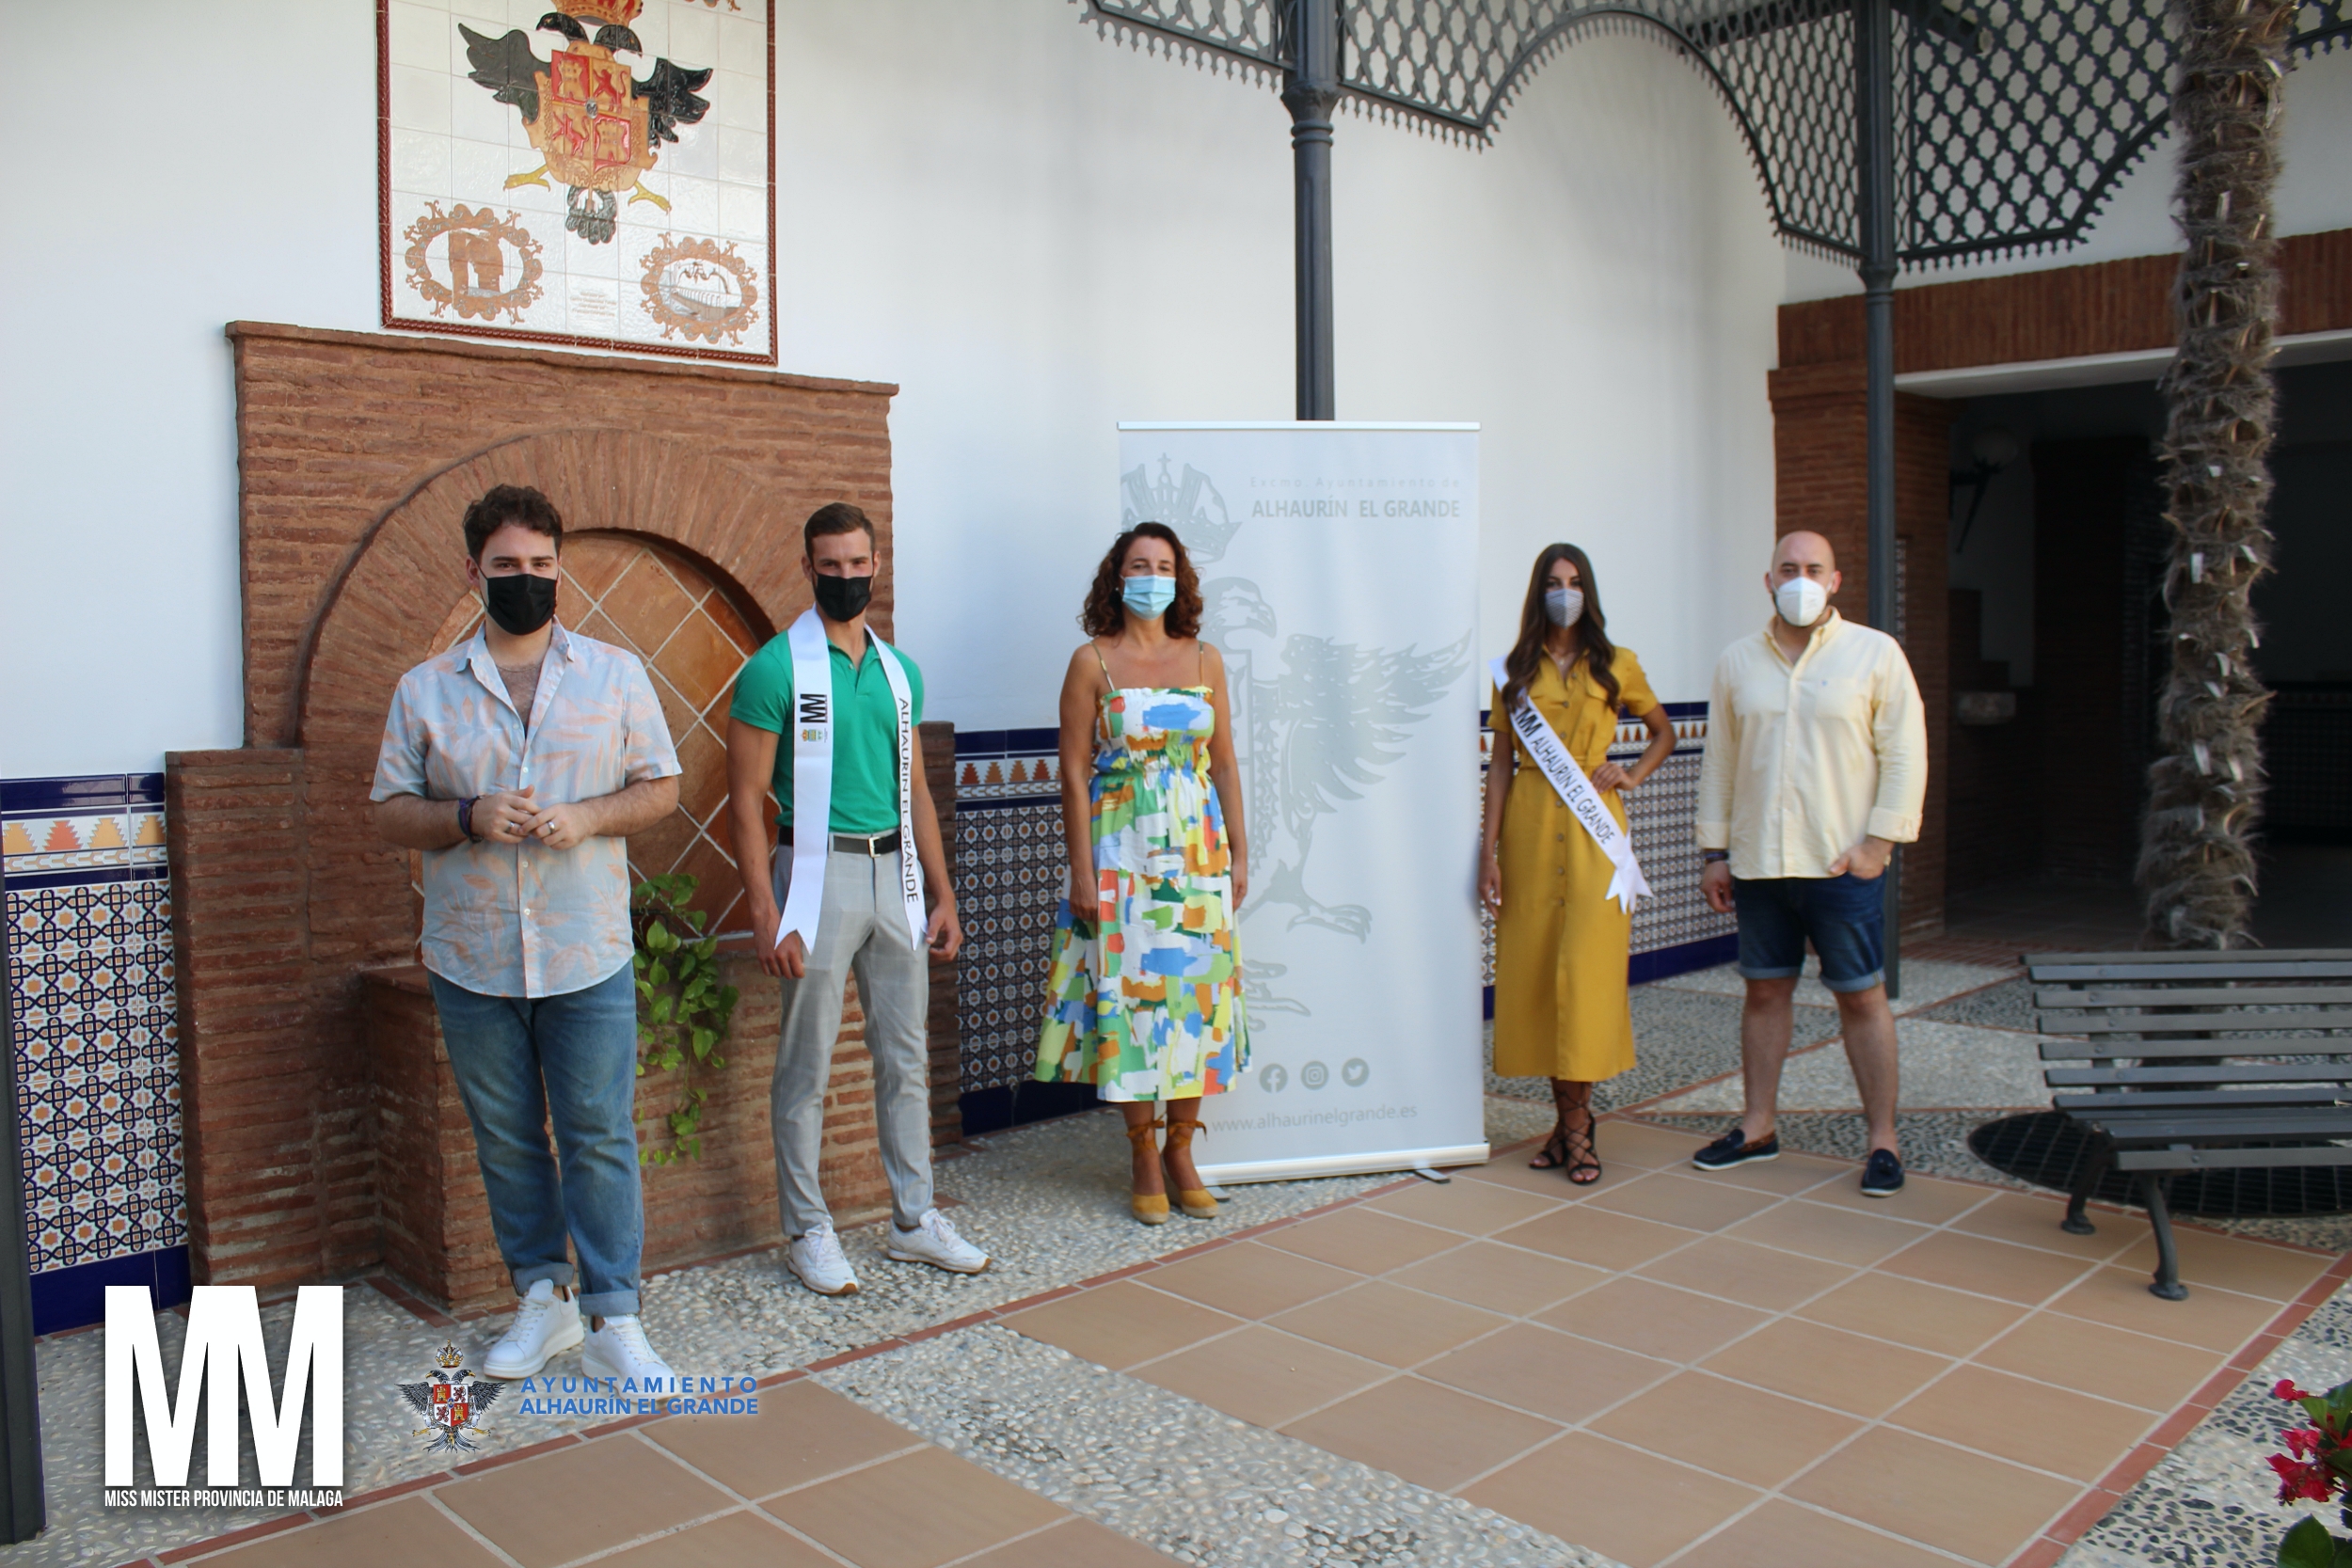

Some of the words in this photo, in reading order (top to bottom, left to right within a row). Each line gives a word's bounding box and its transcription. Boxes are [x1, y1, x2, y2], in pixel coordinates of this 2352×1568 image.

[1249, 476, 1310, 488] Excmo.
[1315, 476, 1437, 491] Ayuntamiento
[1441, 476, 1459, 488] de
[1251, 495, 1348, 518] ALHAURÍN
[1359, 499, 1379, 518] EL
[1384, 499, 1460, 518] GRANDE
[1531, 736, 1578, 790] ALHAURÍN
[1566, 784, 1585, 802] EL
[1577, 798, 1615, 845] GRANDE
[902, 800, 909, 819] EL
[902, 825, 919, 904] GRANDE
[1211, 1103, 1419, 1132] www.alhaurinelgrande.es
